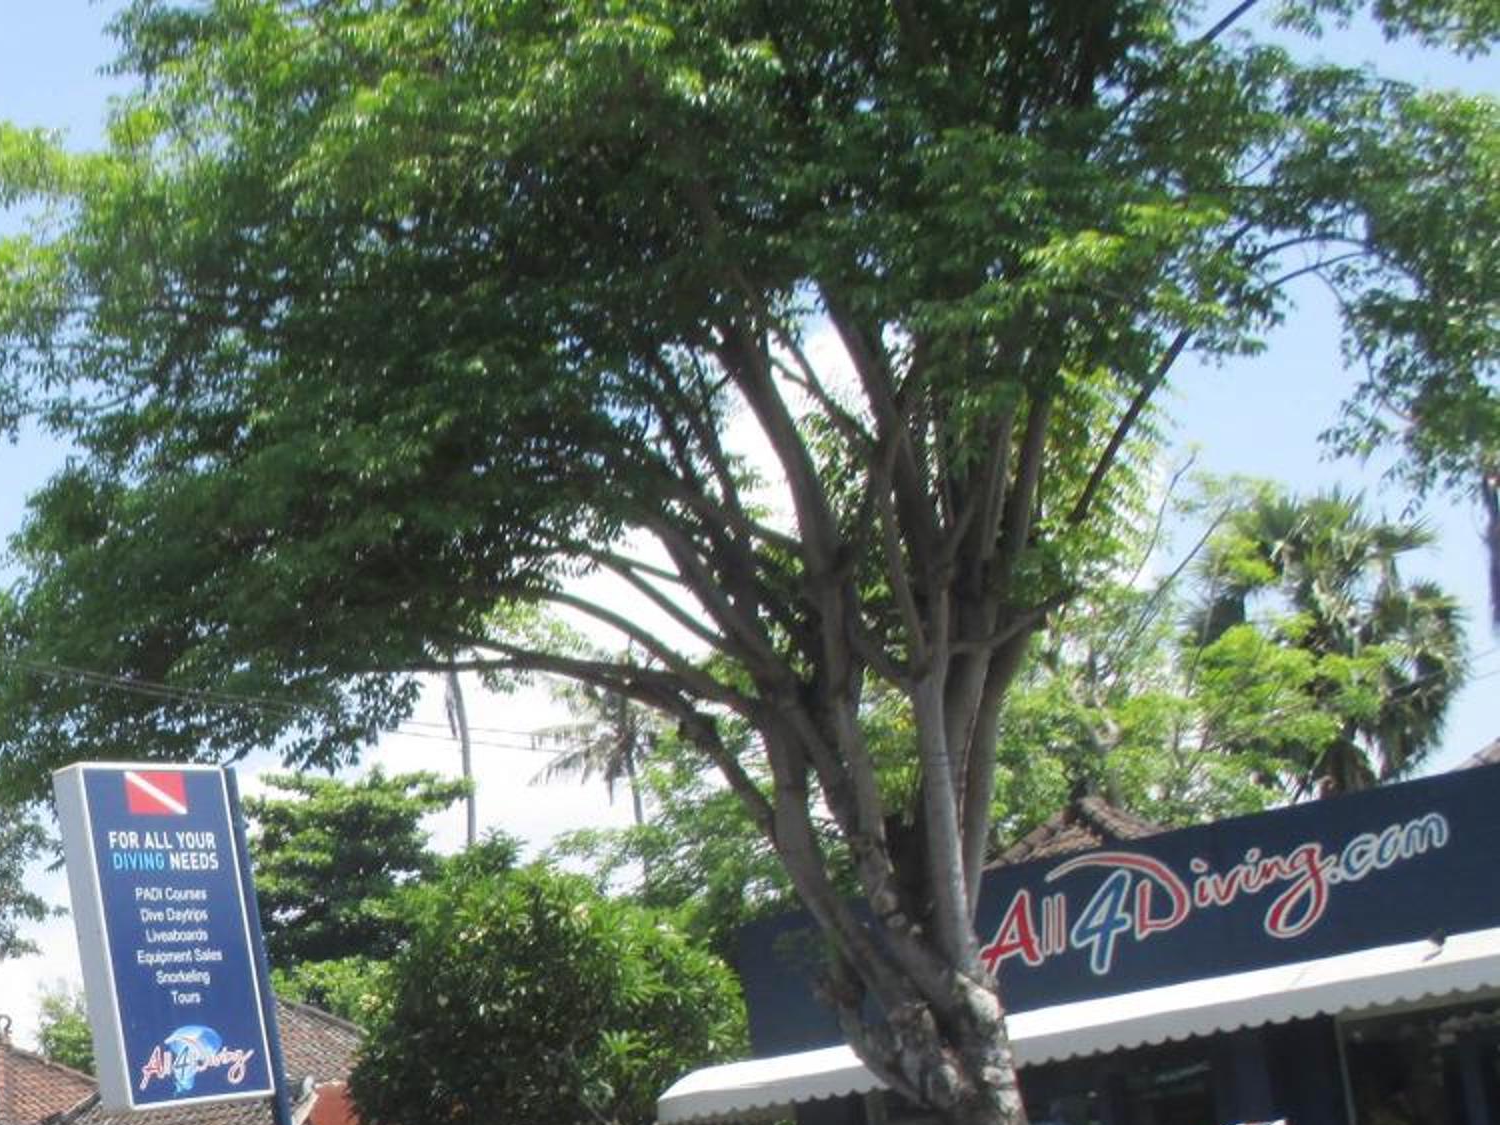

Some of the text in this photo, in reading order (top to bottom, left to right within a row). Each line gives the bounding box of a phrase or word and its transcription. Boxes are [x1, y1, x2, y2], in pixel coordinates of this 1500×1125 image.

[108, 831, 216, 849] FOR ALL YOUR
[113, 852, 219, 870] DIVING NEEDS
[135, 887, 207, 901] PADI Courses
[140, 908, 164, 922] Dive
[145, 928, 208, 943] Liveaboards
[137, 947, 222, 966] Equipment Sales
[156, 969, 211, 985] Snorkeling
[170, 990, 201, 1004] Tours
